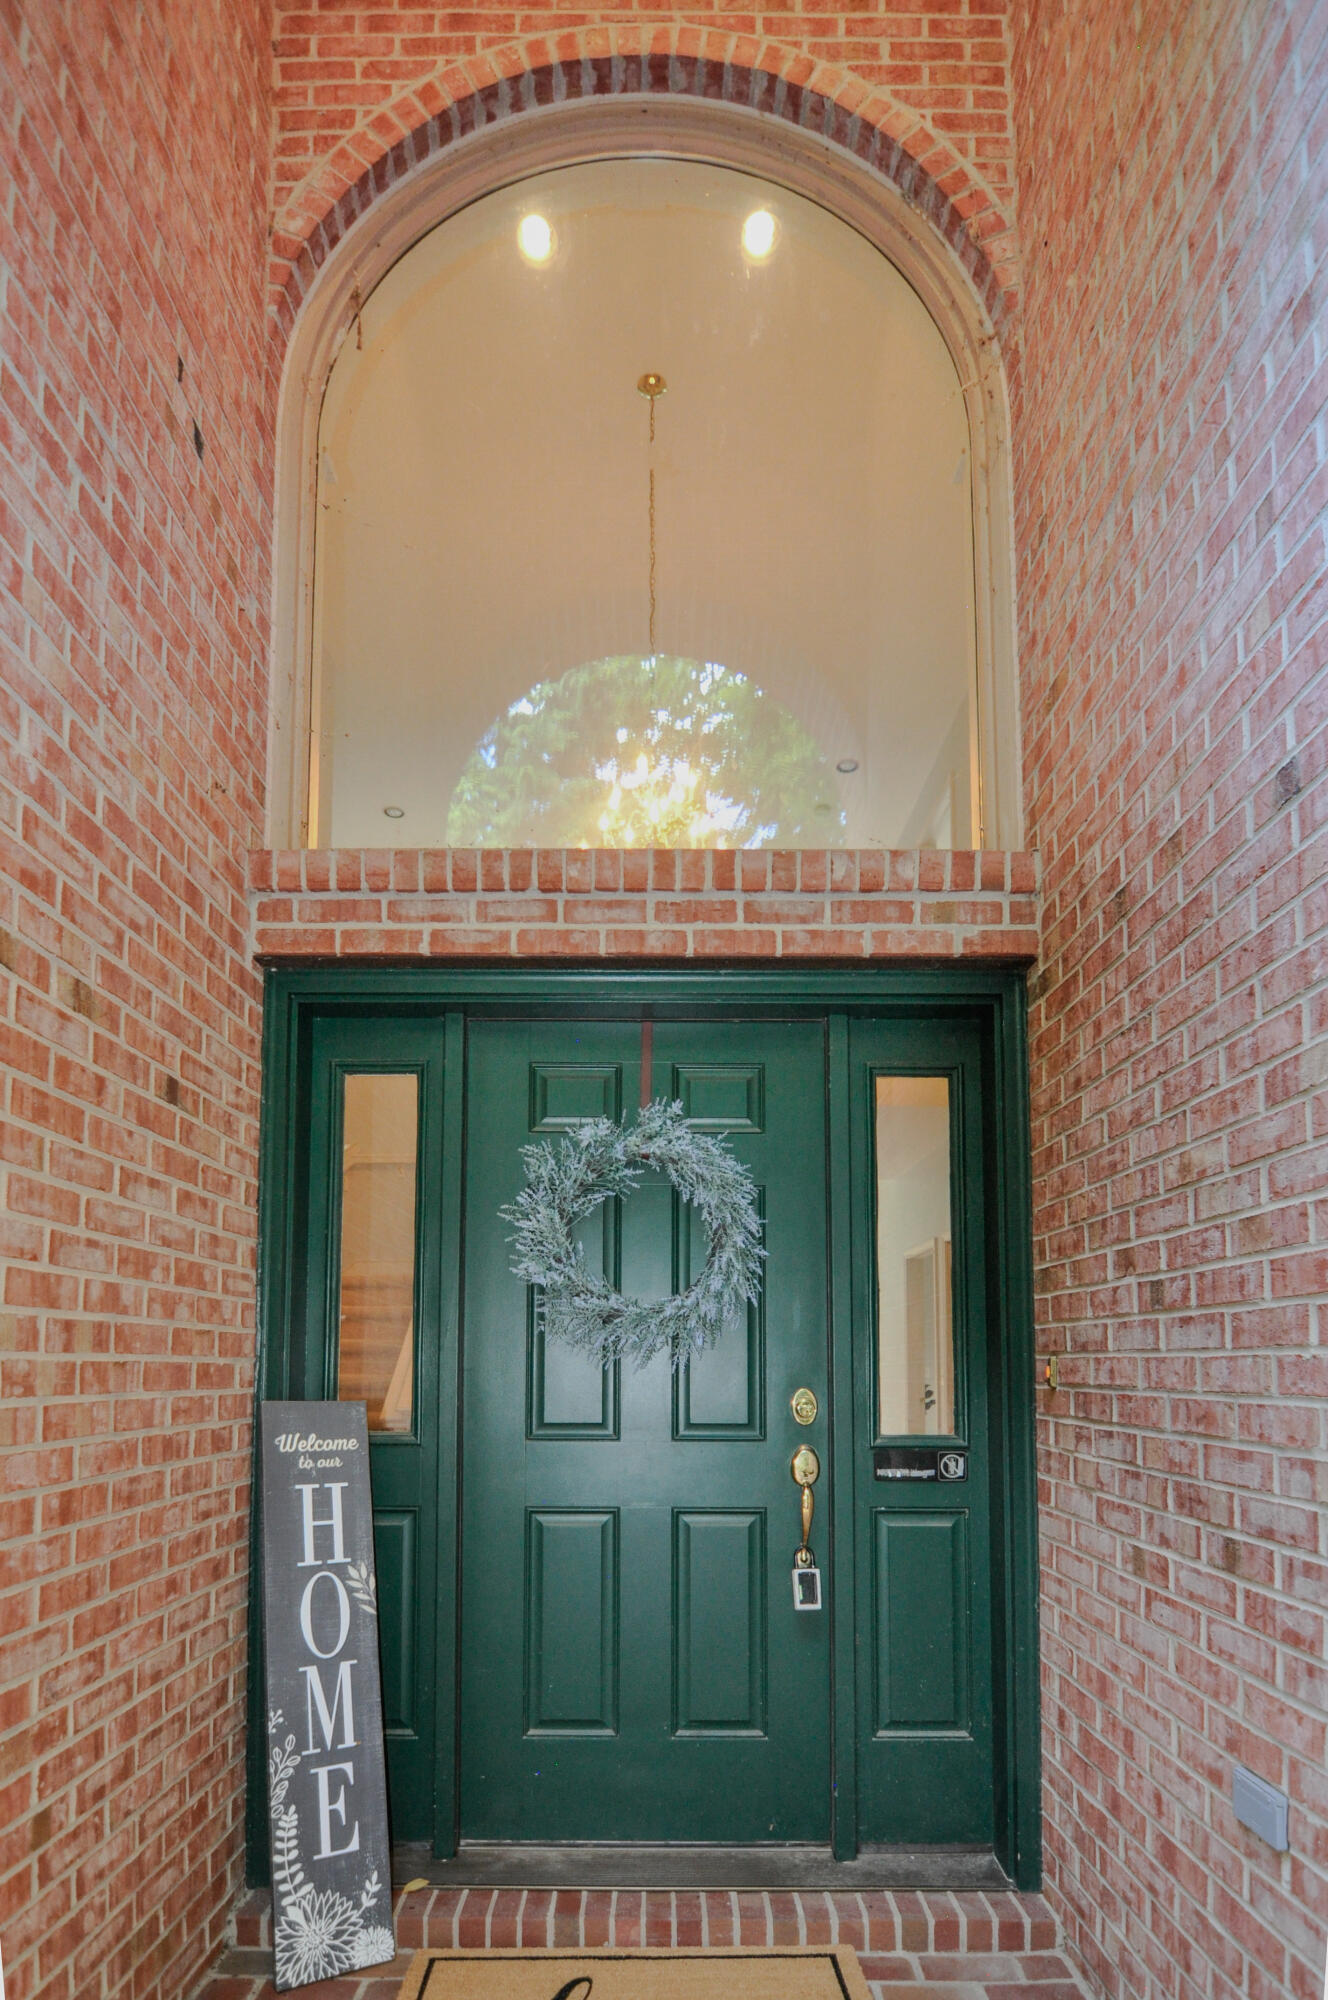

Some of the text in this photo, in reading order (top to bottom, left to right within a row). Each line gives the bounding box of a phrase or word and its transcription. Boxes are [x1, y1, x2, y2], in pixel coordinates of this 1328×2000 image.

[275, 1432, 360, 1453] Welcome
[299, 1455, 343, 1470] to our
[294, 1482, 360, 1860] HOME
